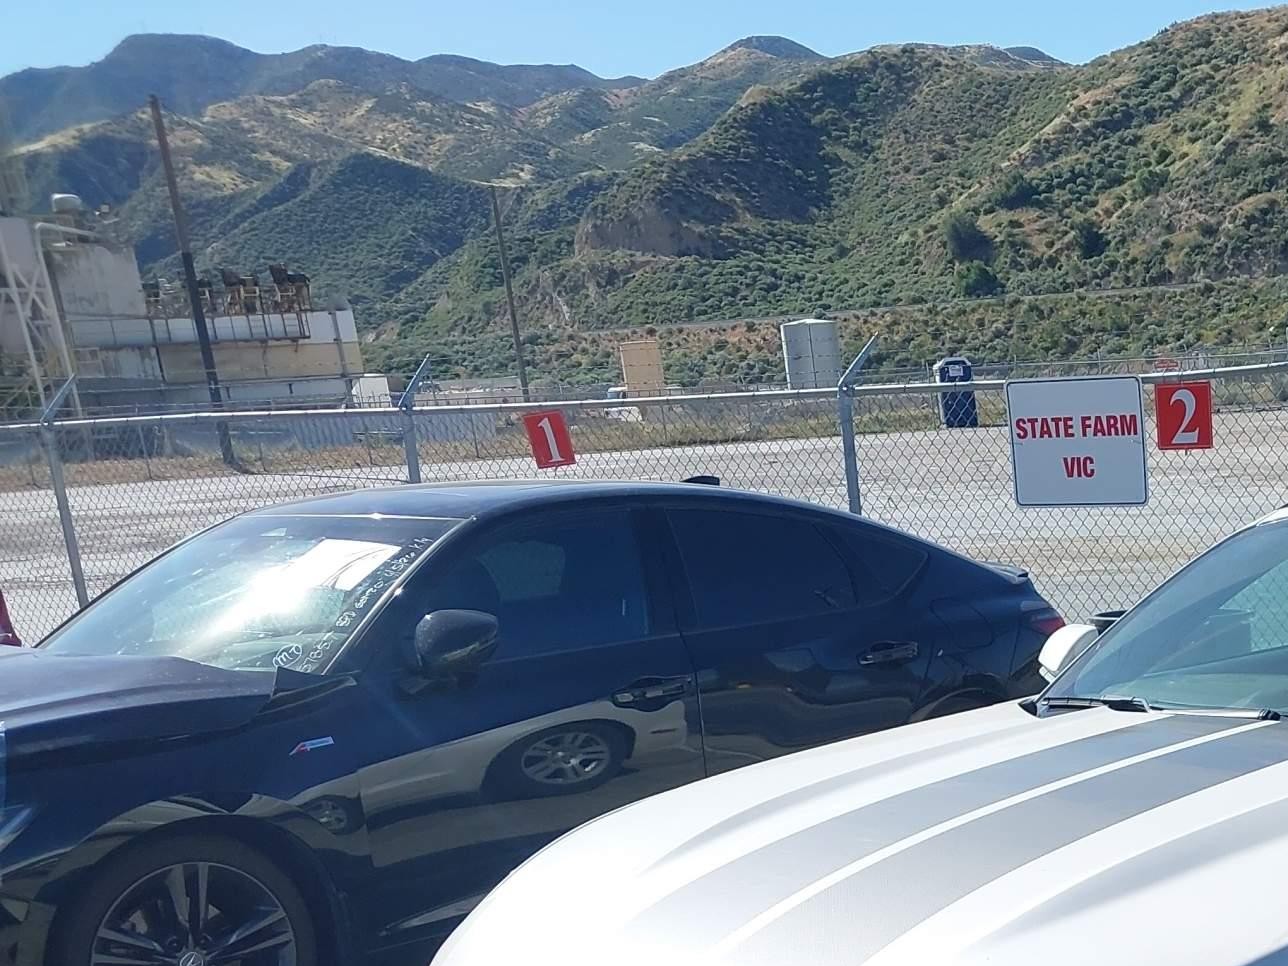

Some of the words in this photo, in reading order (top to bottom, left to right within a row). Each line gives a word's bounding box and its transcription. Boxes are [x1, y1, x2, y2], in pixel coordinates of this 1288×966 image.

[1015, 417, 1075, 440] STATE
[1081, 414, 1138, 438] FARM
[1170, 389, 1199, 444] 2
[538, 417, 565, 462] 1
[1063, 456, 1095, 479] VIC
